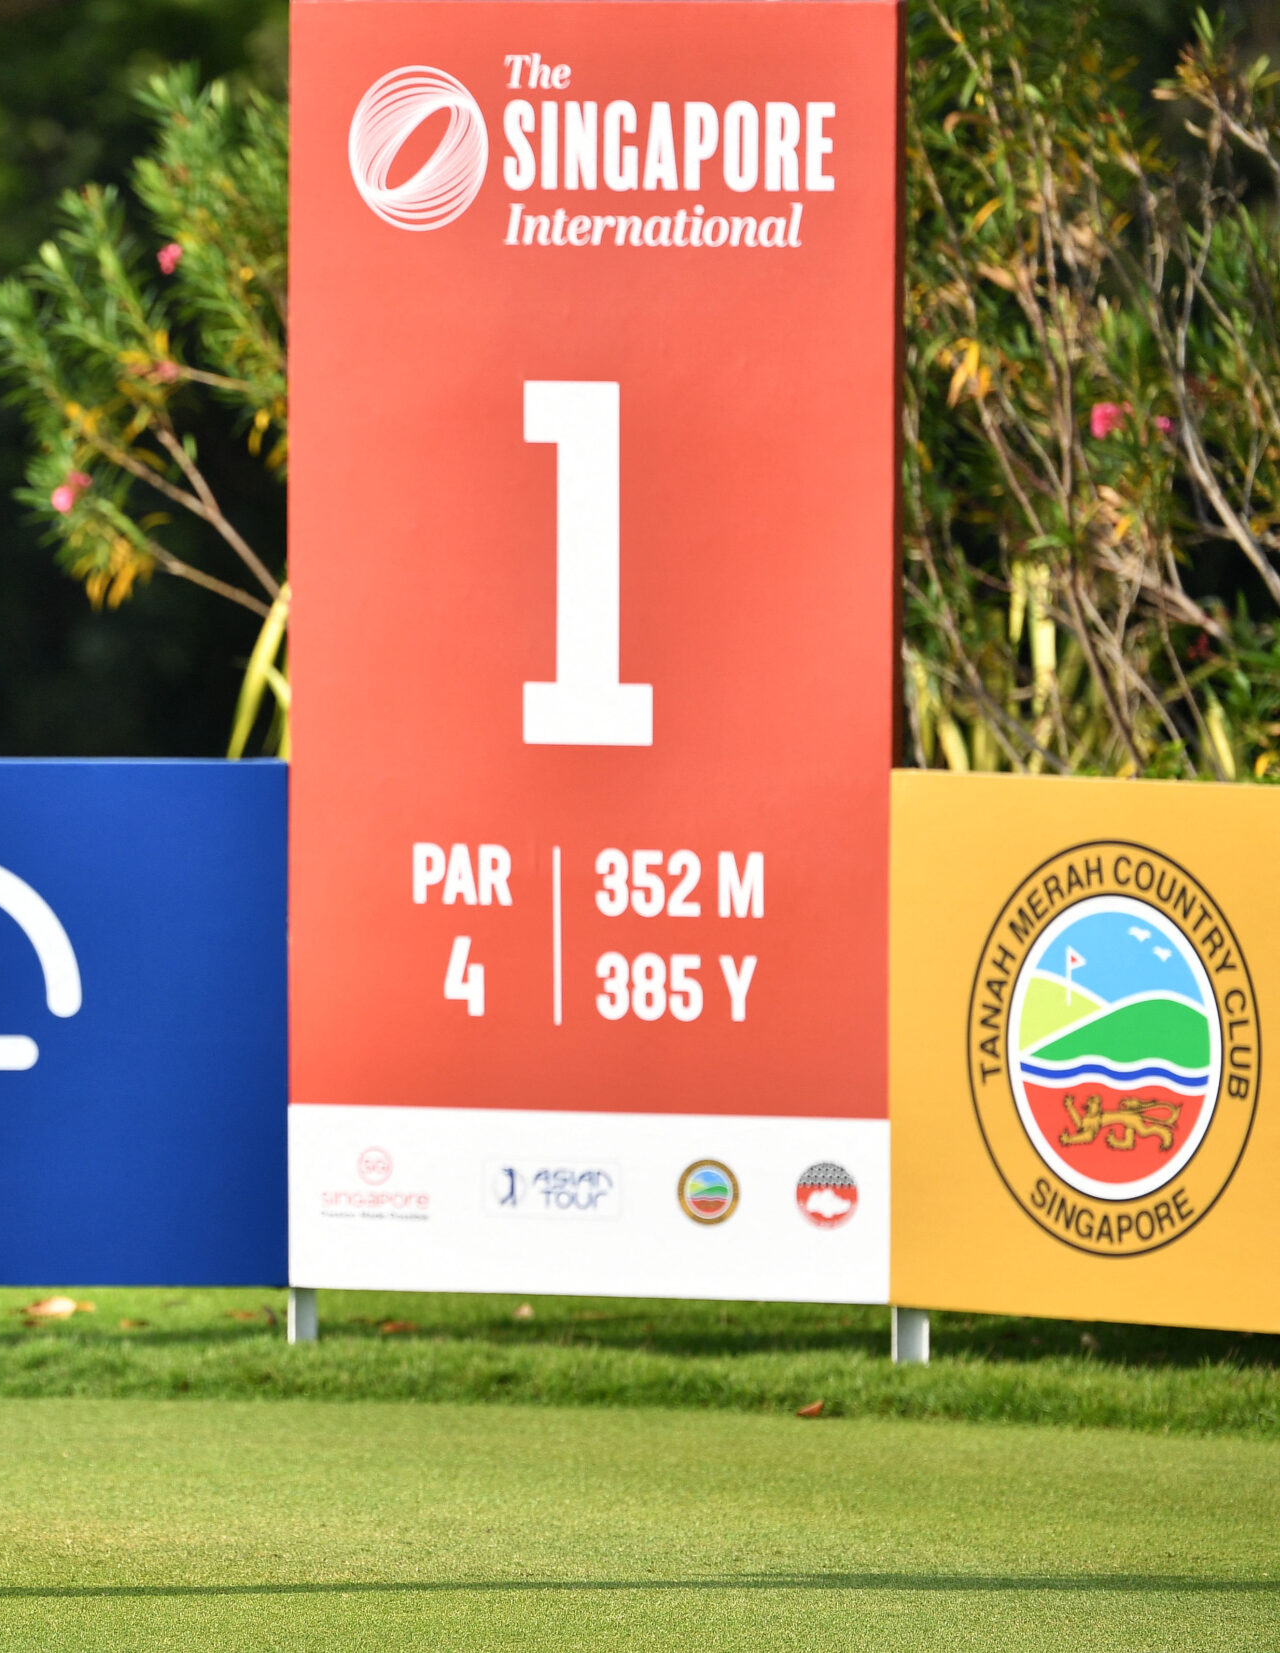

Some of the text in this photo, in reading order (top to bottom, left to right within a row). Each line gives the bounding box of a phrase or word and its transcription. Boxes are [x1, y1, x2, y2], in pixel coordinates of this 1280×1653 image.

[503, 52, 572, 90] The
[502, 99, 837, 193] SINGAPORE
[503, 202, 804, 248] International
[522, 379, 654, 747] 1
[412, 841, 513, 907] PAR
[594, 847, 765, 919] 352 M
[443, 935, 485, 1017] 4
[595, 951, 758, 1022] 385 Y
[979, 856, 1252, 1102] TANAH MERAH COUNTRY CLUB
[1030, 1177, 1194, 1244] SINGAPORE
